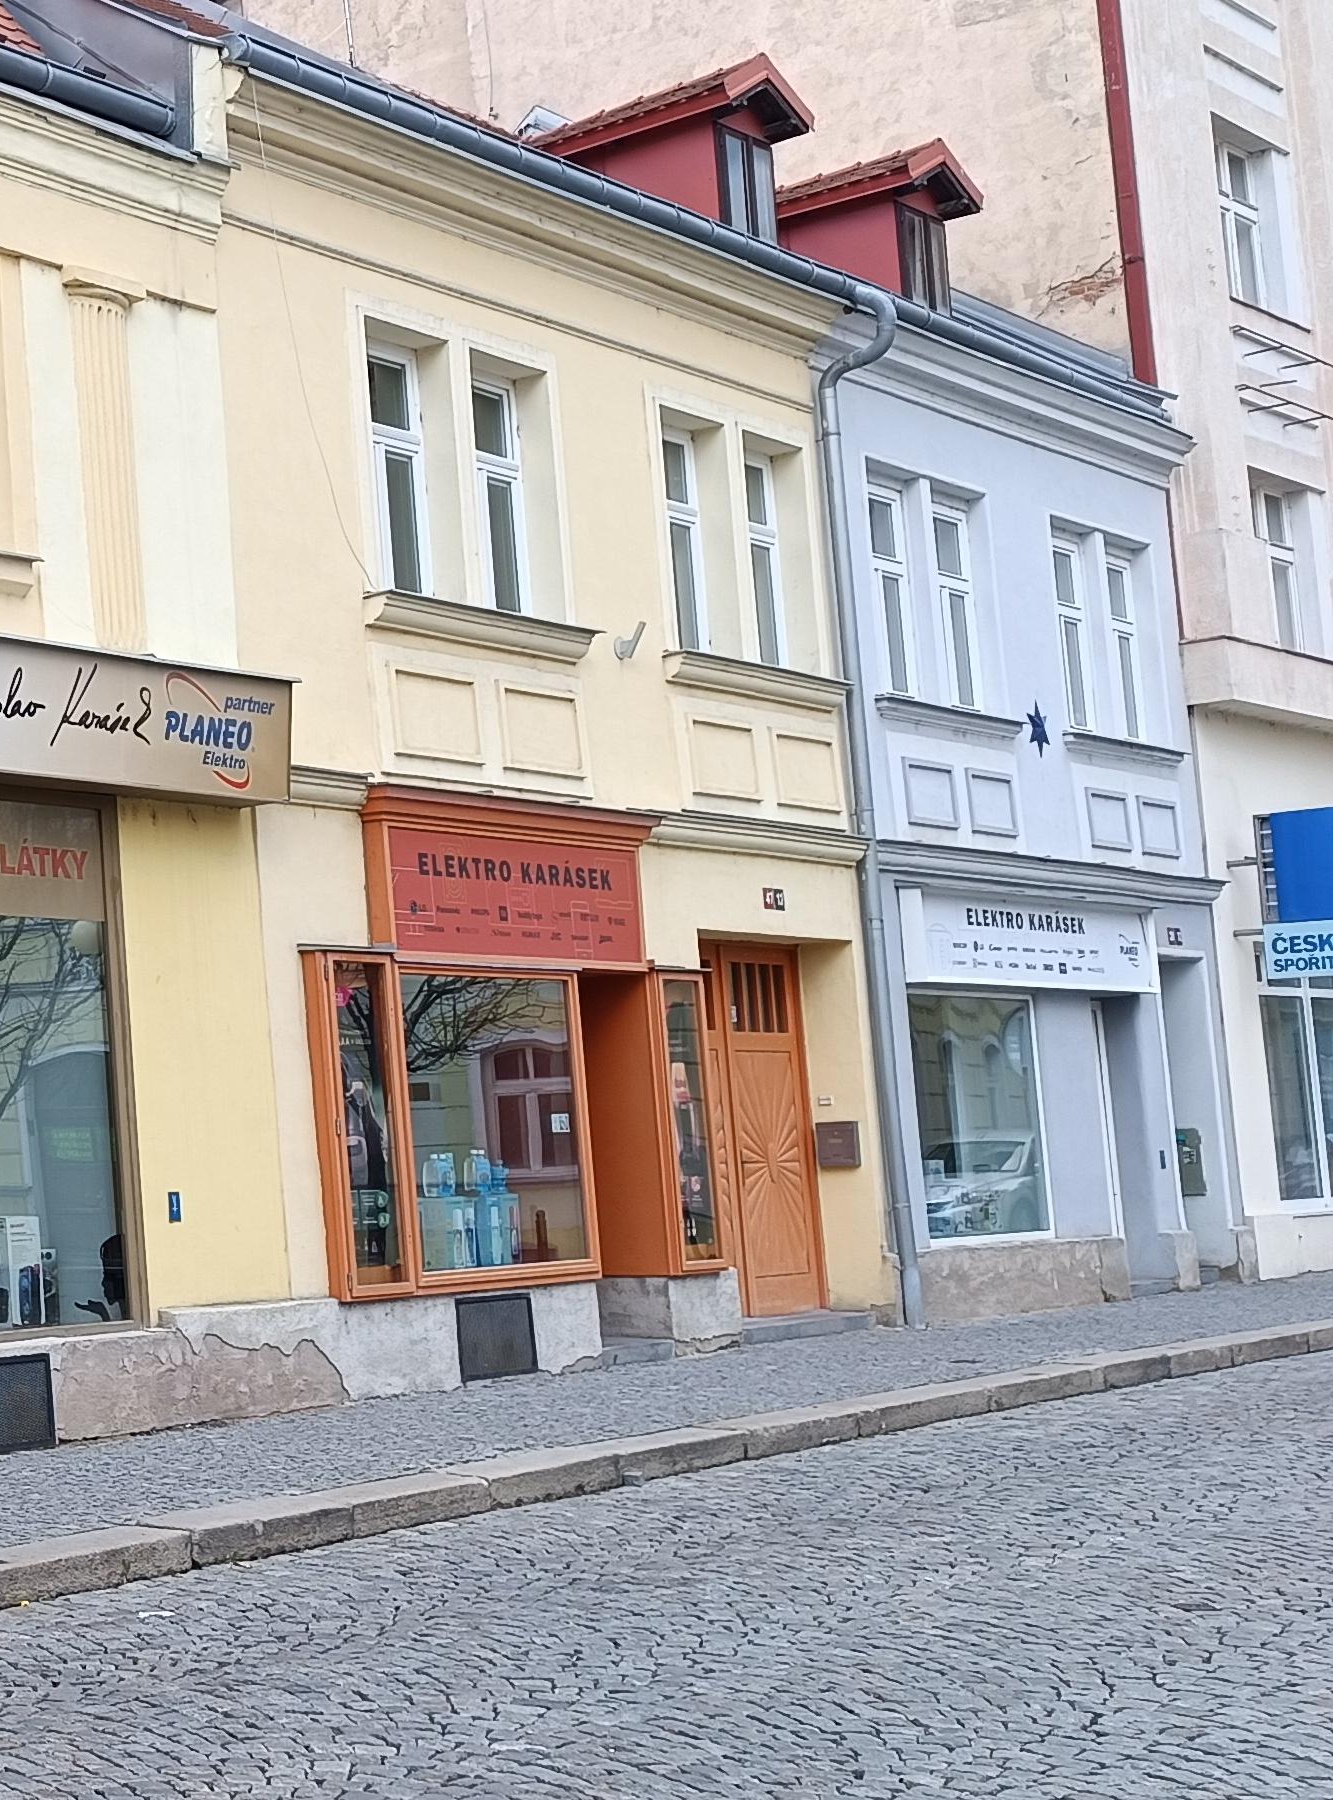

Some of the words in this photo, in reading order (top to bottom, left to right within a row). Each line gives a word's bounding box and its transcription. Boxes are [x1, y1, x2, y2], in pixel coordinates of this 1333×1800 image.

[224, 695, 275, 716] partner
[164, 710, 252, 752] PLANEO
[202, 750, 247, 770] Elektro
[418, 852, 512, 883] ELEKTRO
[521, 860, 612, 891] KARÁSEK
[966, 907, 1023, 930] ELEKTRO
[1028, 911, 1085, 935] KARÁSEK
